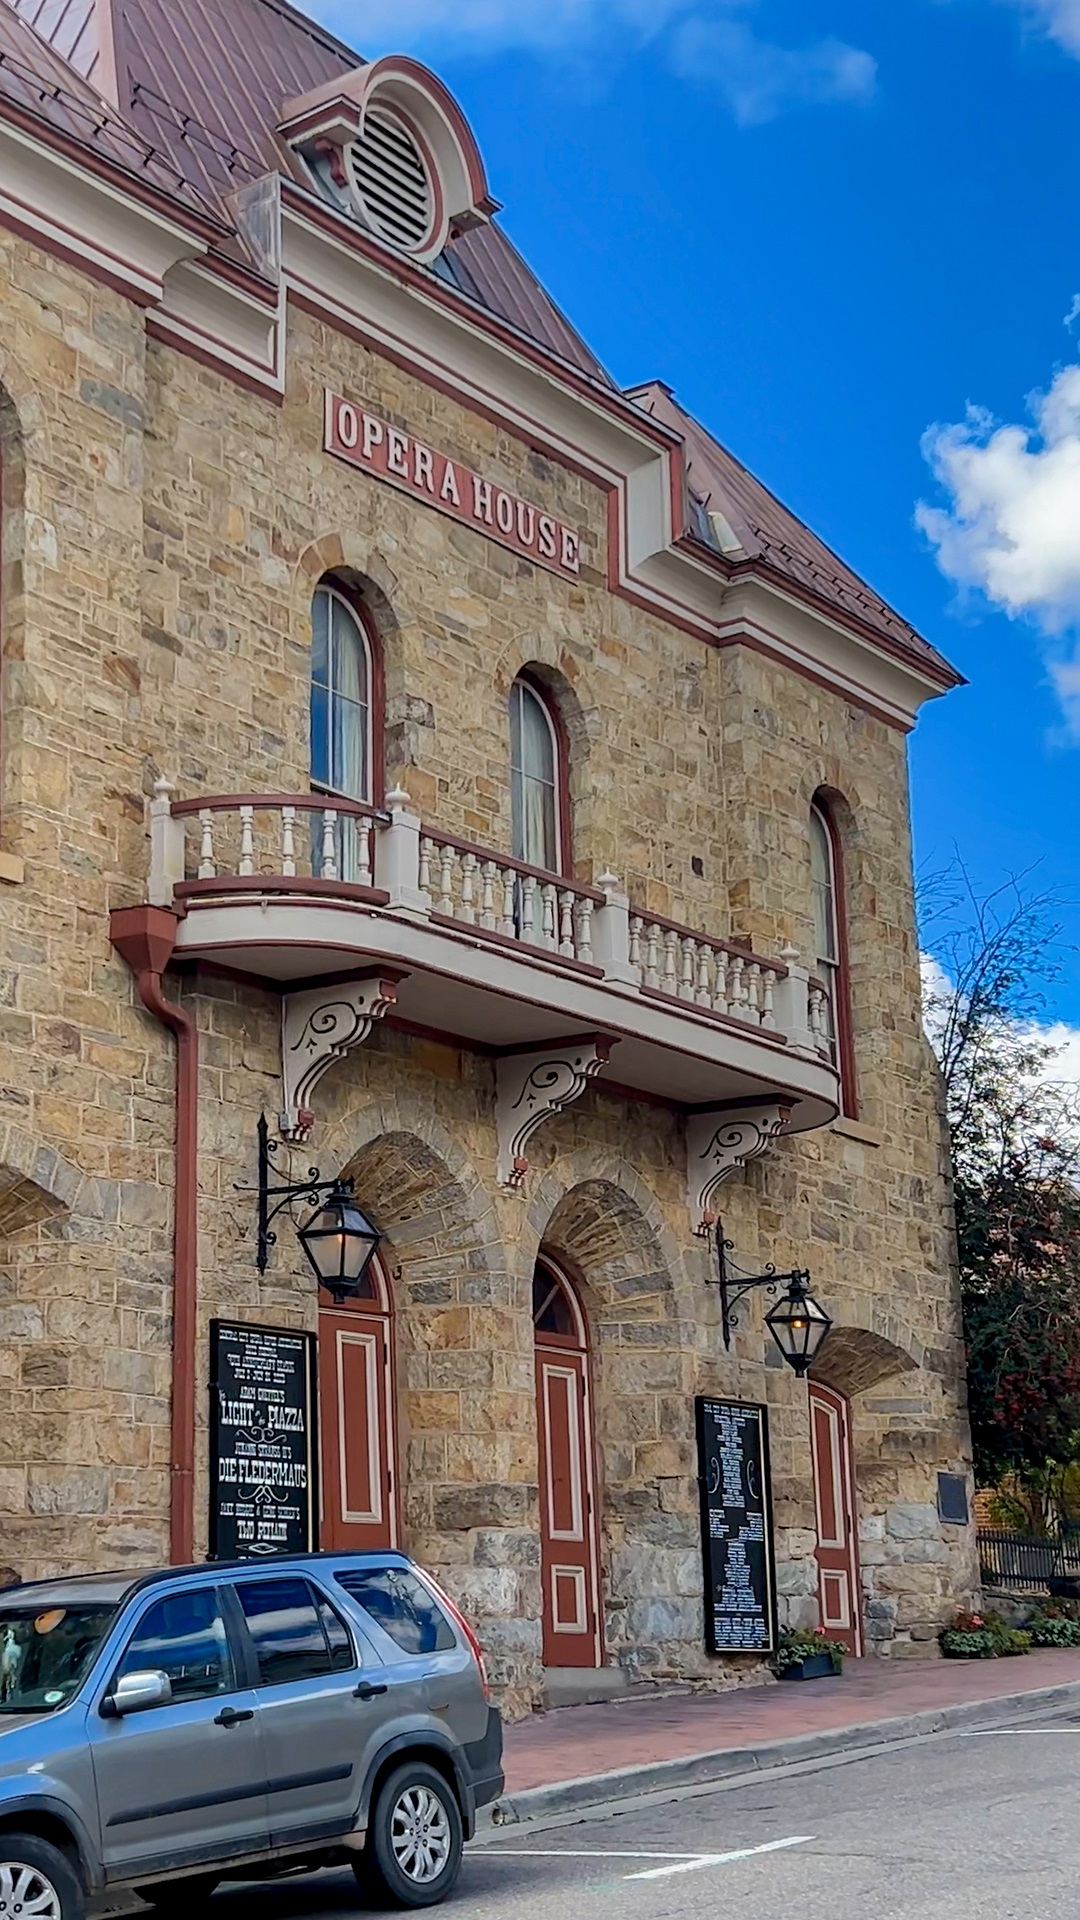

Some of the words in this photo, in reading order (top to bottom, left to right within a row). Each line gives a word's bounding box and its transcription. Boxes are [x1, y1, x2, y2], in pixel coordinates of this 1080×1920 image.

[338, 403, 460, 506] OPERA
[472, 475, 580, 574] HOUSE
[221, 1401, 254, 1427] LIGHT
[268, 1405, 304, 1432] PIAZZA
[219, 1457, 237, 1482] DIE
[238, 1458, 307, 1488] FLEDERMAUS
